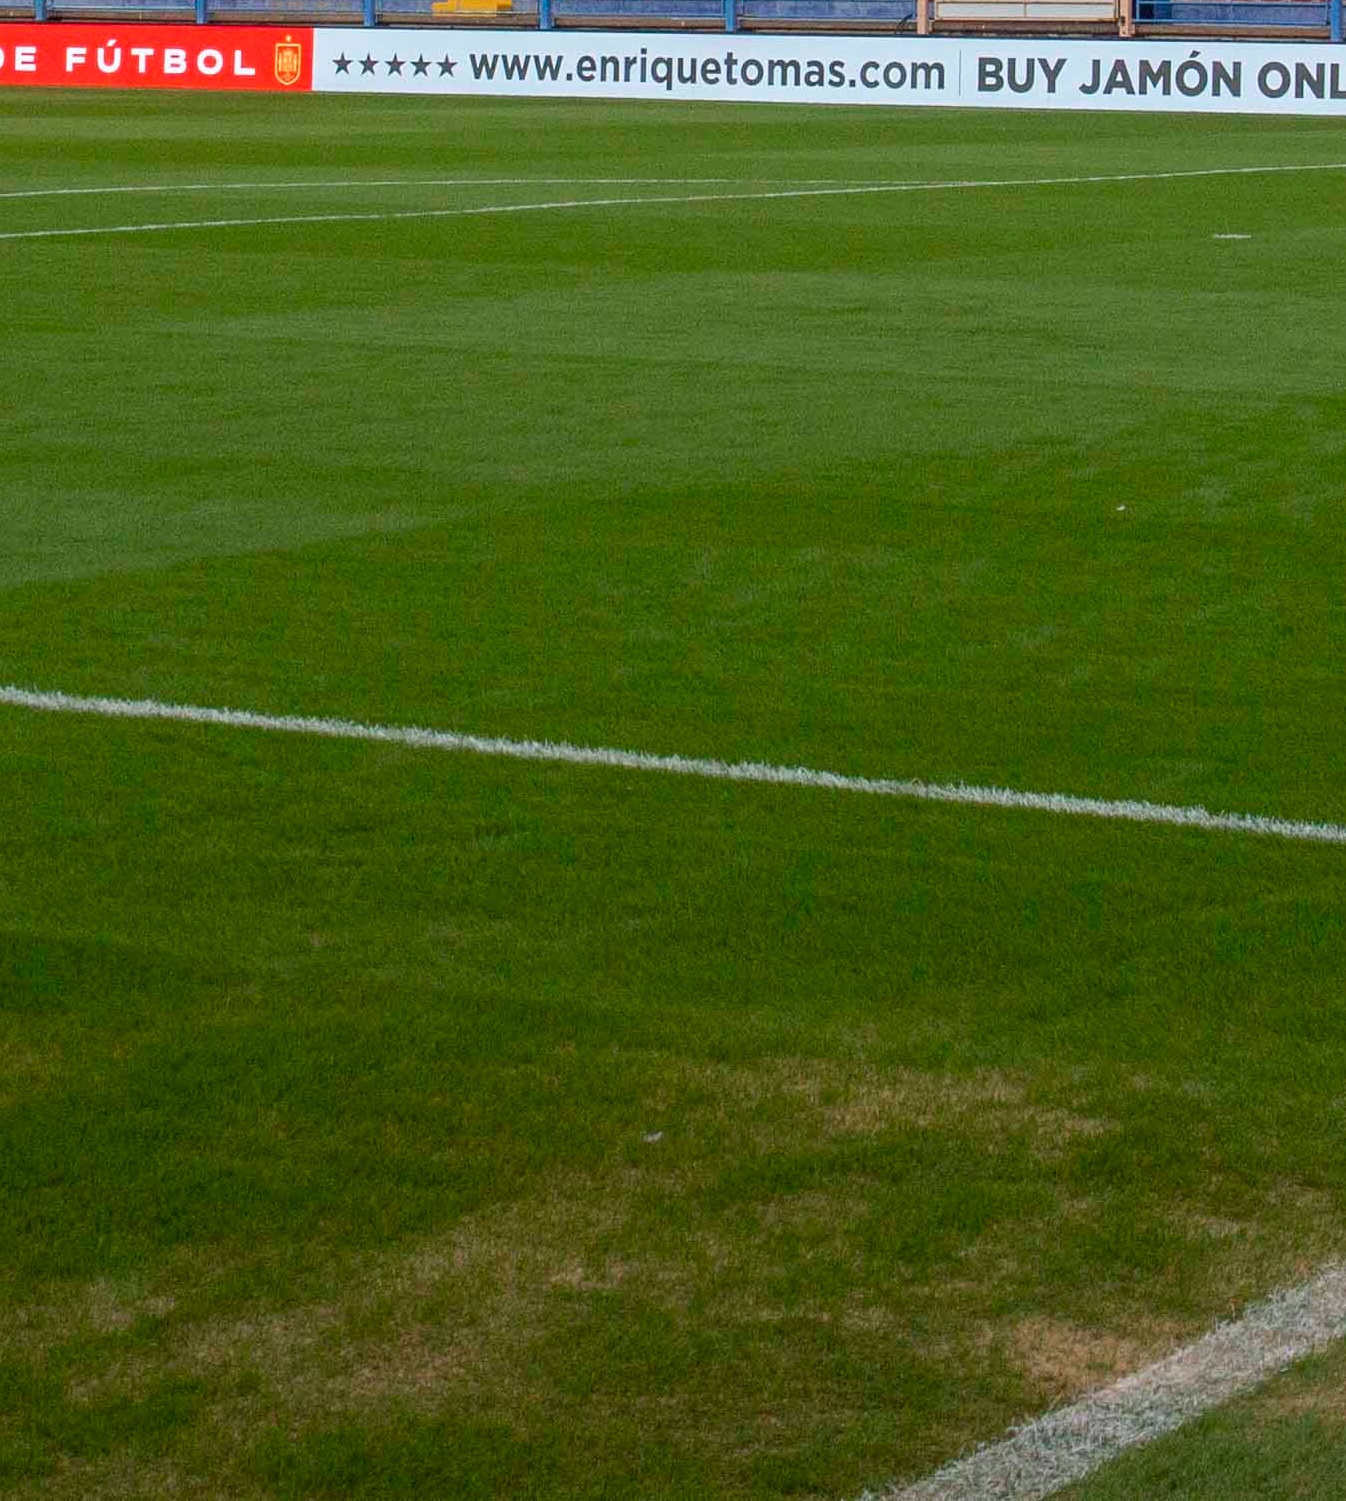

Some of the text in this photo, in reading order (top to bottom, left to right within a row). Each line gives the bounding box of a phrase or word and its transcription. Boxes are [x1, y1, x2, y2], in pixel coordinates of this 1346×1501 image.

[65, 39, 257, 76] FÚTBOL
[469, 48, 945, 91] www.enriquetomas.com
[977, 57, 1067, 95] BUY
[1080, 50, 1242, 100] JAMÓN
